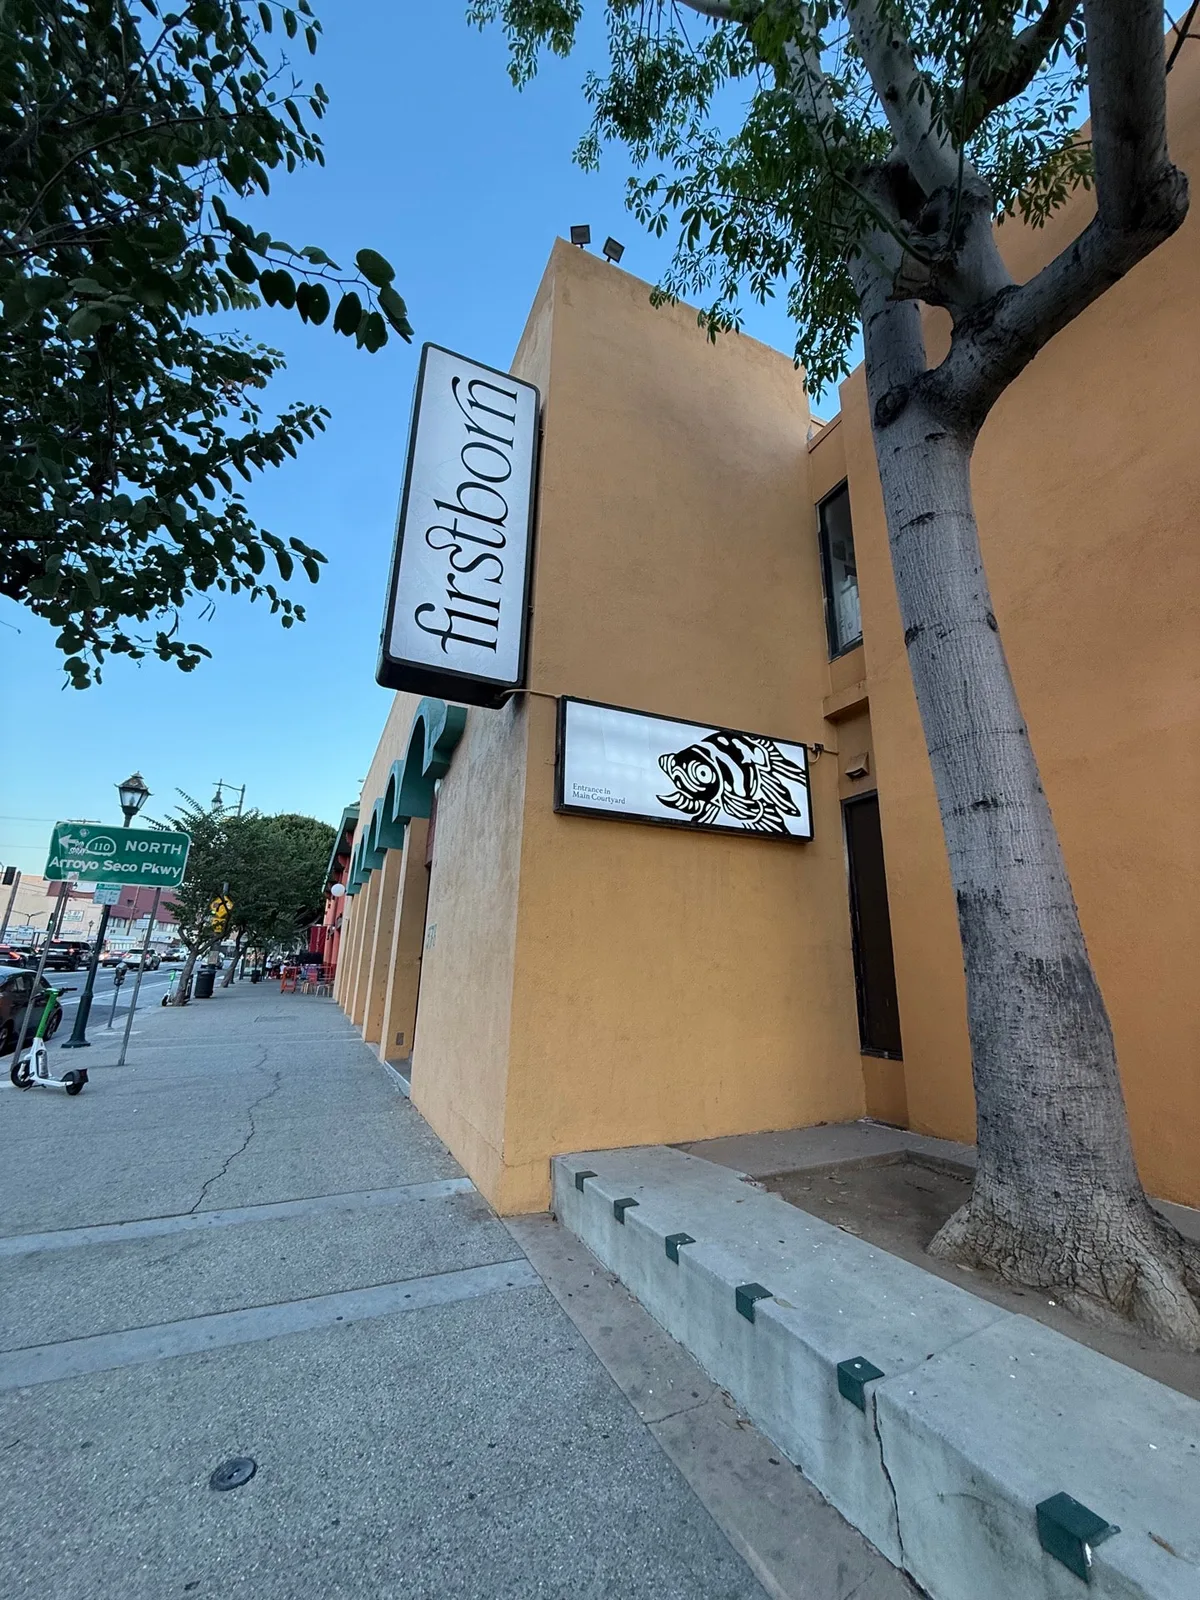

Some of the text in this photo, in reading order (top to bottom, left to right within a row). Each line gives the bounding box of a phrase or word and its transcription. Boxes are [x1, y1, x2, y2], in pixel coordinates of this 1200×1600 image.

[414, 375, 519, 654] firstborn
[572, 782, 604, 794] Entrance
[572, 790, 626, 805] Main Courtyard
[93, 842, 111, 852] 110
[125, 840, 183, 855] NORTH
[49, 856, 182, 878] Arroyo Seco Pkwy
